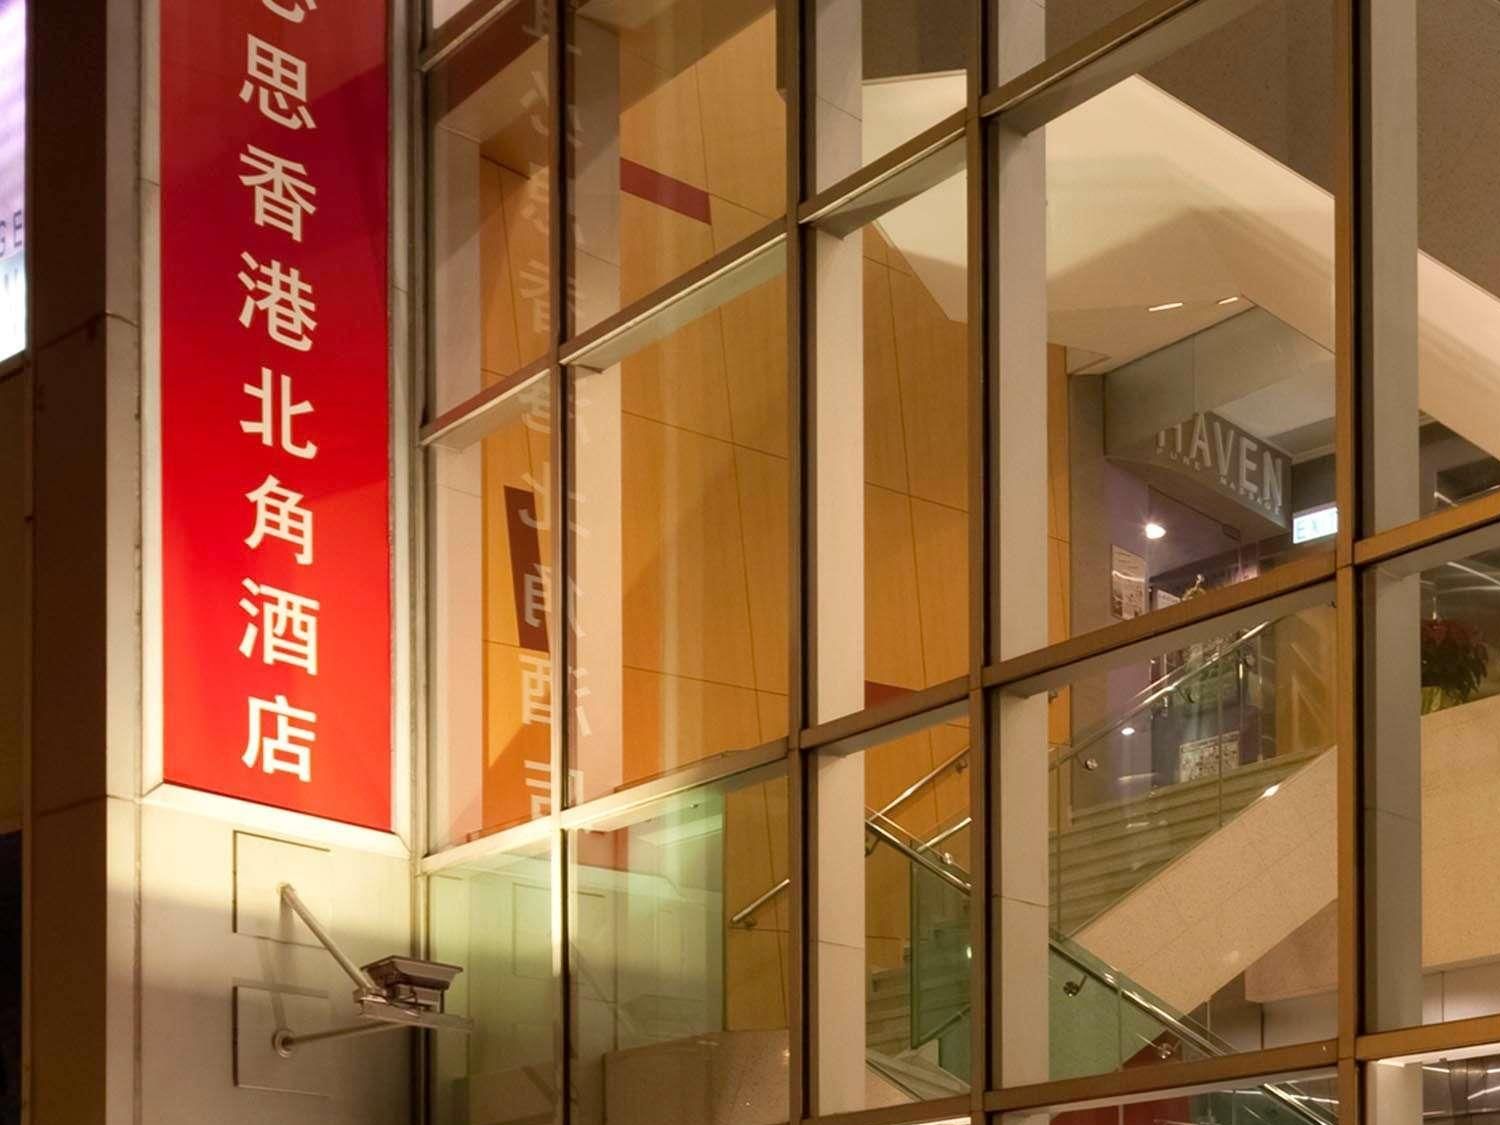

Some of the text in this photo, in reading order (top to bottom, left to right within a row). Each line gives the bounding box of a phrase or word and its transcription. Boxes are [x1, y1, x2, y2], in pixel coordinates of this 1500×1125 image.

[239, 0, 320, 784] 思香港北角酒店
